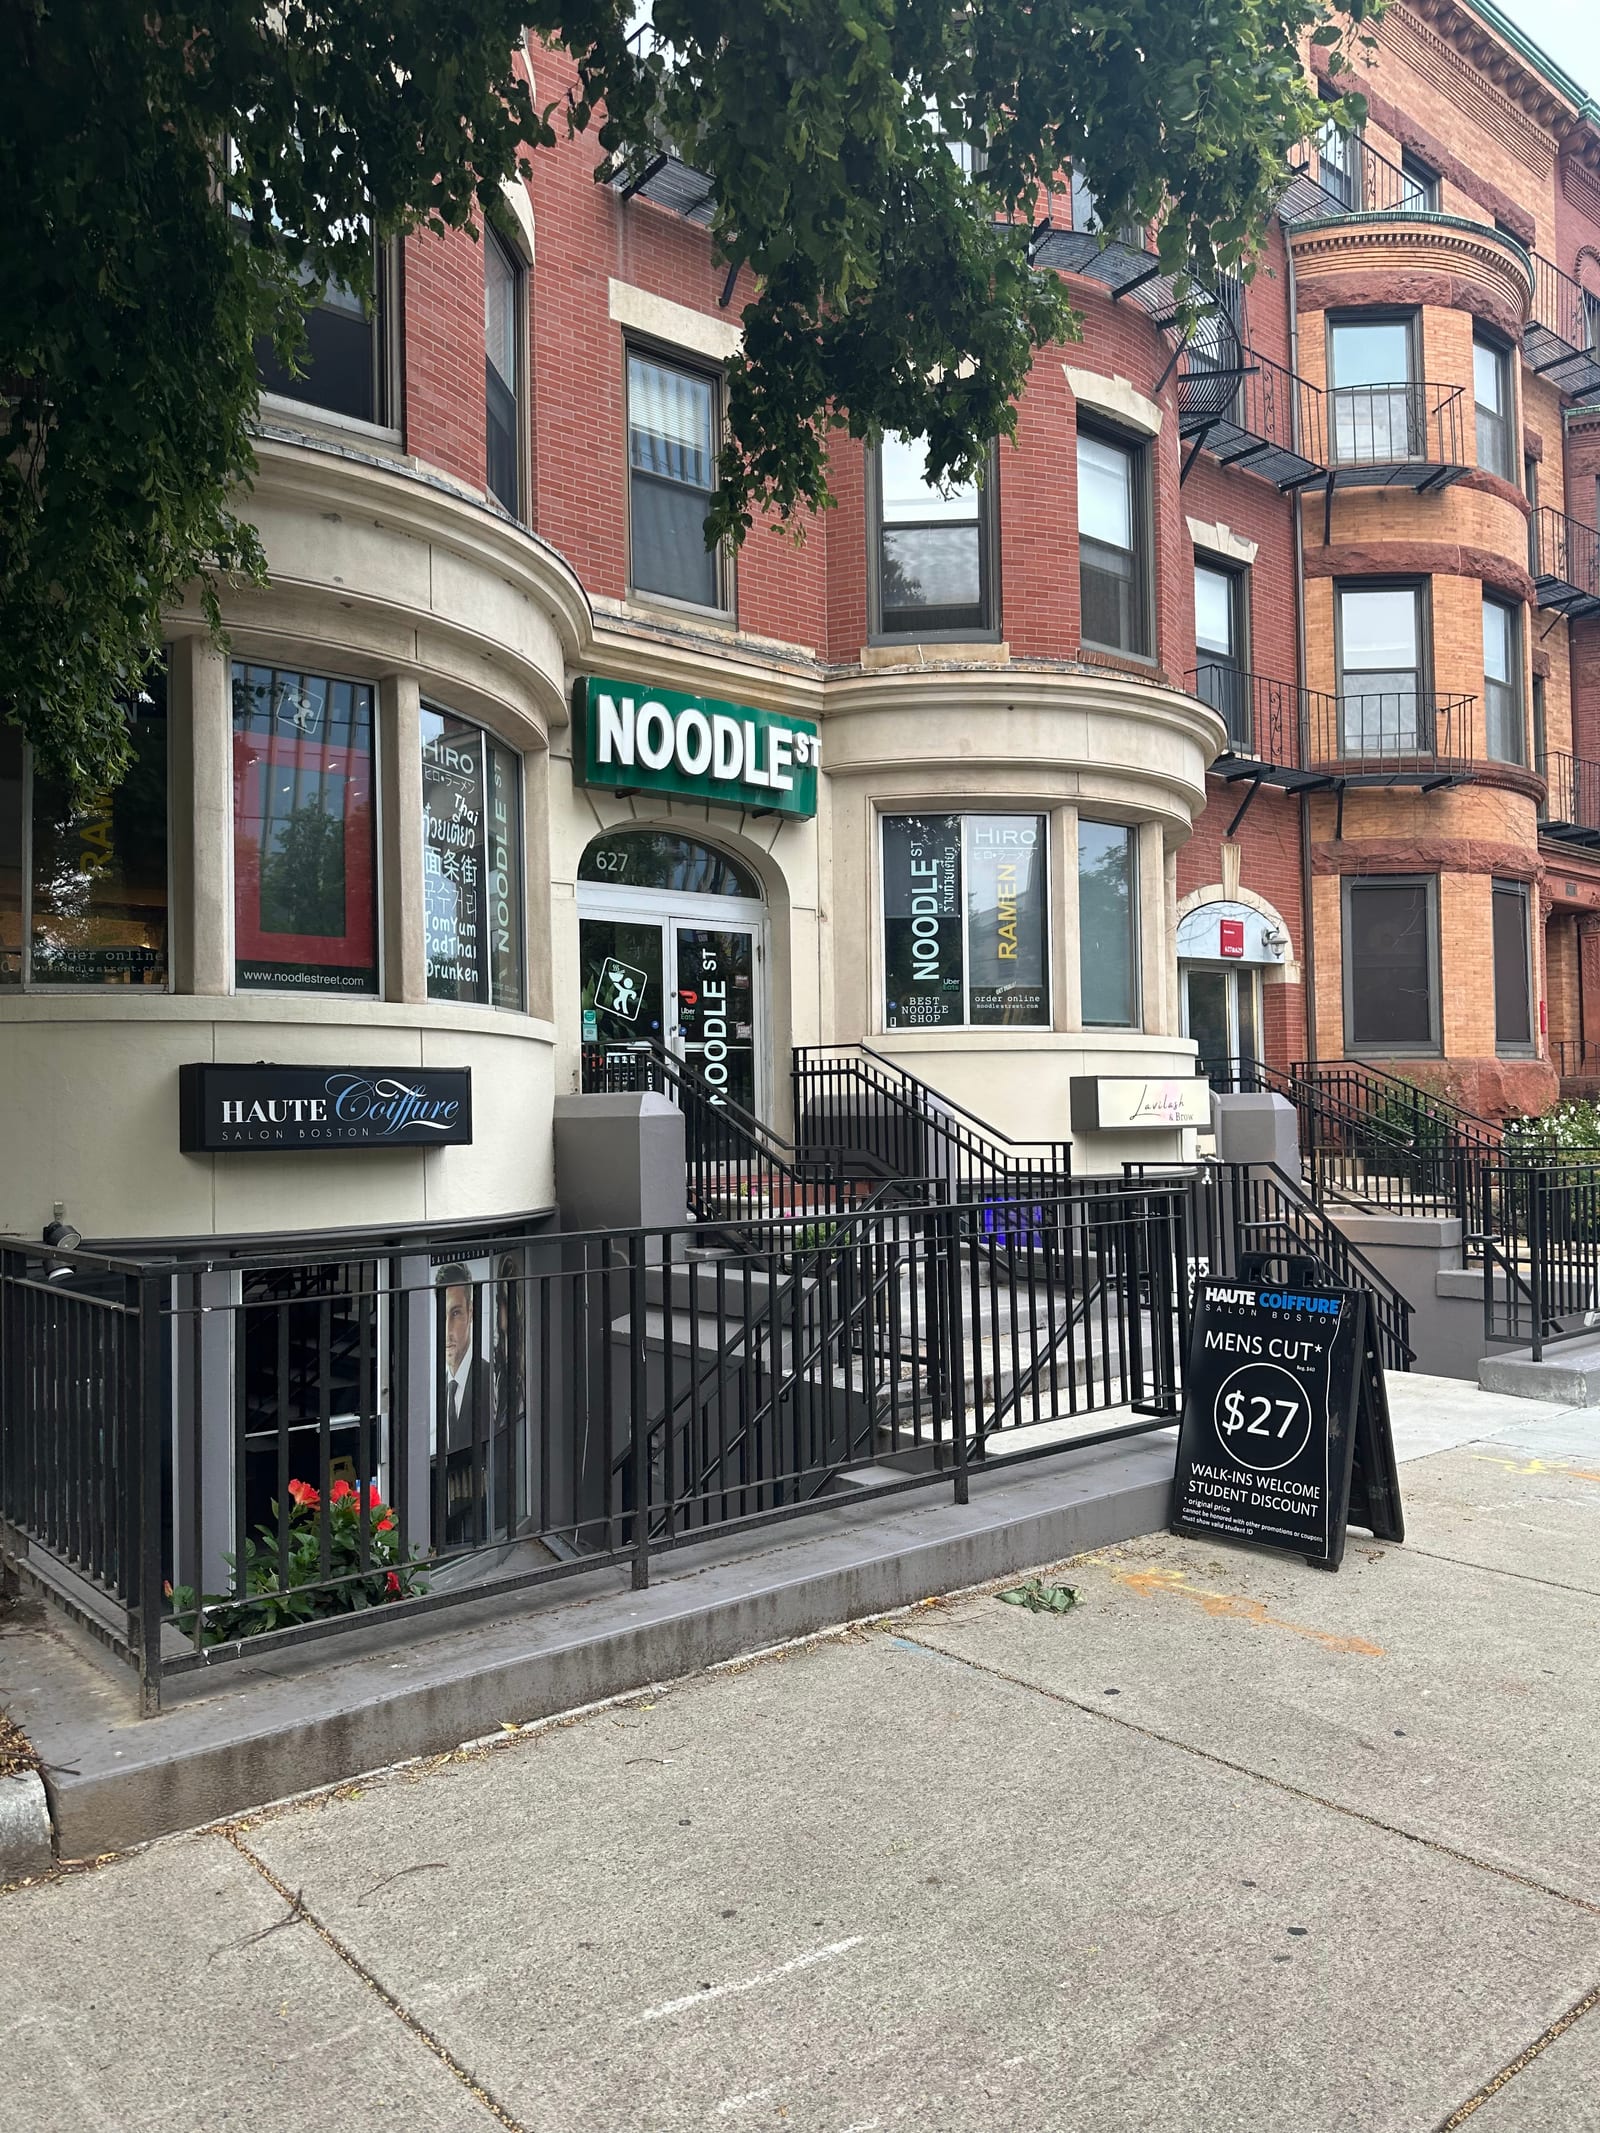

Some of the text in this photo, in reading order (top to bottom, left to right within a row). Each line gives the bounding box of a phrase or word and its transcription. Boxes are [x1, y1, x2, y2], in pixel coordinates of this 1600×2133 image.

[596, 694, 822, 791] NOODLE ST
[422, 736, 474, 774] HIRO
[454, 793, 479, 827] Thai
[80, 786, 114, 878] RAM
[975, 827, 1037, 845] HIRO
[494, 750, 510, 953] NOODLE ST
[596, 851, 628, 872] 627
[424, 845, 478, 887] 面条街
[910, 840, 940, 980] NOODLE ST
[997, 864, 1018, 959] RAMEN
[427, 958, 479, 983] Drunken
[702, 948, 717, 971] ST
[243, 971, 364, 986] www.noodlestreet.com
[901, 1005, 949, 1015] NOODLE
[909, 997, 940, 1006] BEST
[1007, 994, 1041, 1003] online
[680, 1007, 696, 1015] Uber
[910, 1014, 941, 1023] SHOP
[221, 1073, 460, 1136] HAUTE Coiffure
[1175, 1112, 1194, 1121] Brow
[222, 1127, 370, 1141] SALON BOSTON
[1205, 1287, 1256, 1306] HAUTE
[1205, 1304, 1338, 1326] SALON BOSTON
[1204, 1330, 1263, 1355] MENS
[1222, 1389, 1299, 1439] $27
[1191, 1462, 1321, 1499] WALK-INS WELCOME
[1188, 1480, 1318, 1517] STUDENT DISCOUNT
[1188, 1498, 1231, 1514] original price
[1182, 1506, 1201, 1516] cannot
[1202, 1509, 1210, 1518] be
[1210, 1511, 1232, 1523] honored
[1232, 1516, 1245, 1525] with
[1245, 1519, 1261, 1529] other
[1261, 1524, 1293, 1536] promotions
[1300, 1533, 1324, 1543] coupons
[1182, 1514, 1254, 1535] must show valid student ID
